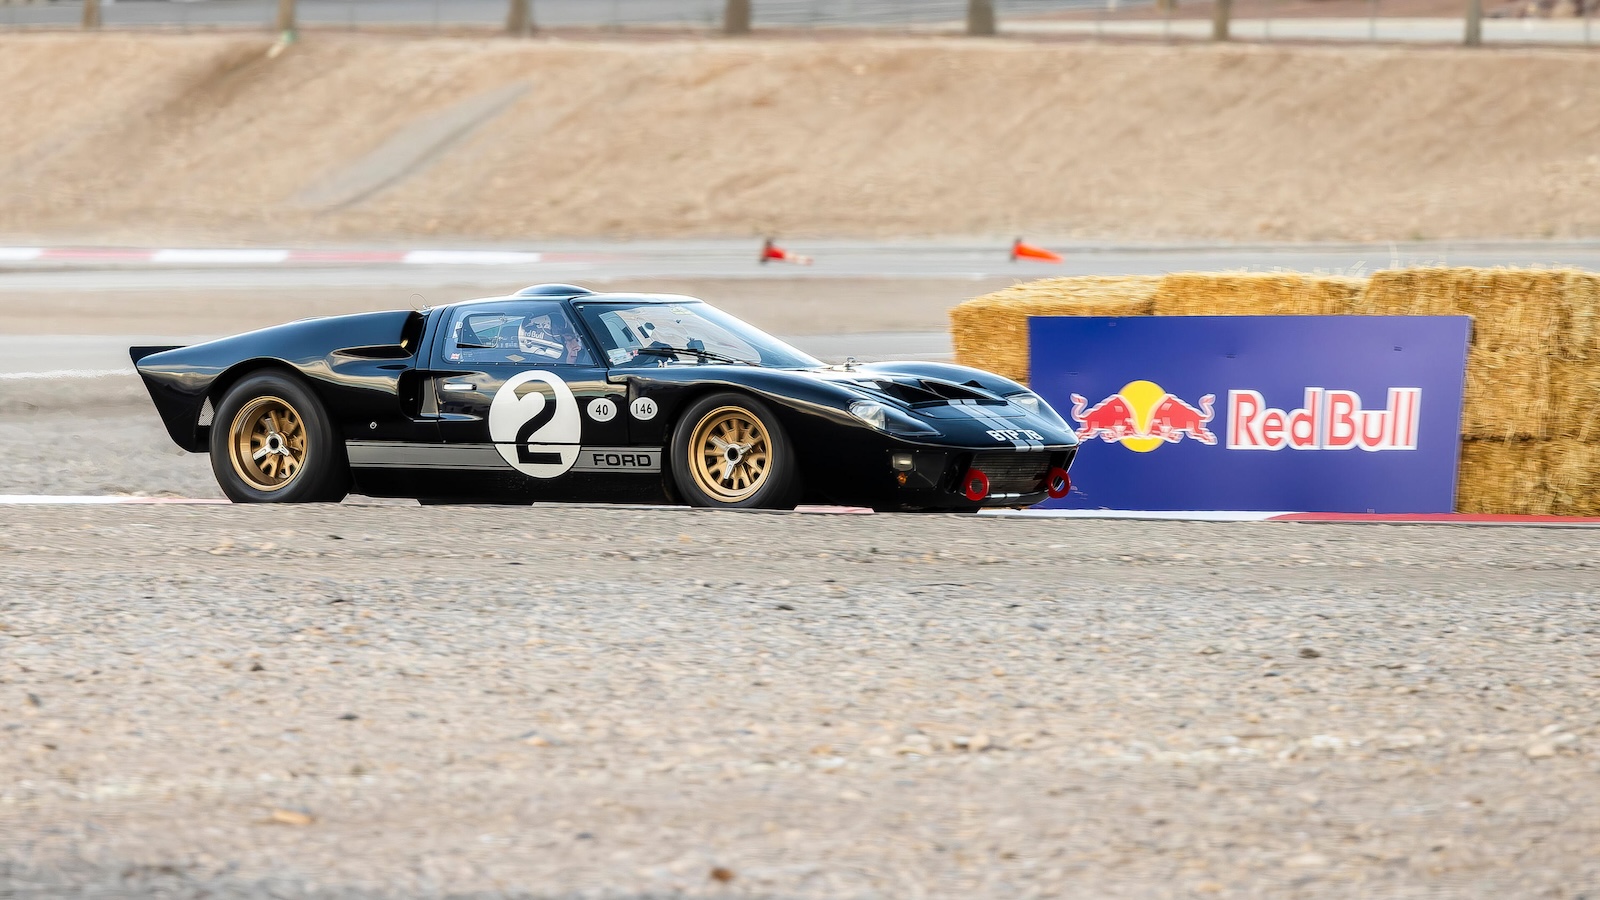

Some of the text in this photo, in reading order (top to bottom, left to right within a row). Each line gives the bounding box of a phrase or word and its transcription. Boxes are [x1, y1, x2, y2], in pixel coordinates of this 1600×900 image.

[595, 404, 609, 416] 40
[635, 403, 652, 415] 146
[513, 379, 563, 465] 2
[1229, 388, 1418, 450] Red Bull
[985, 429, 1020, 441] BTP
[592, 453, 652, 467] FORD
